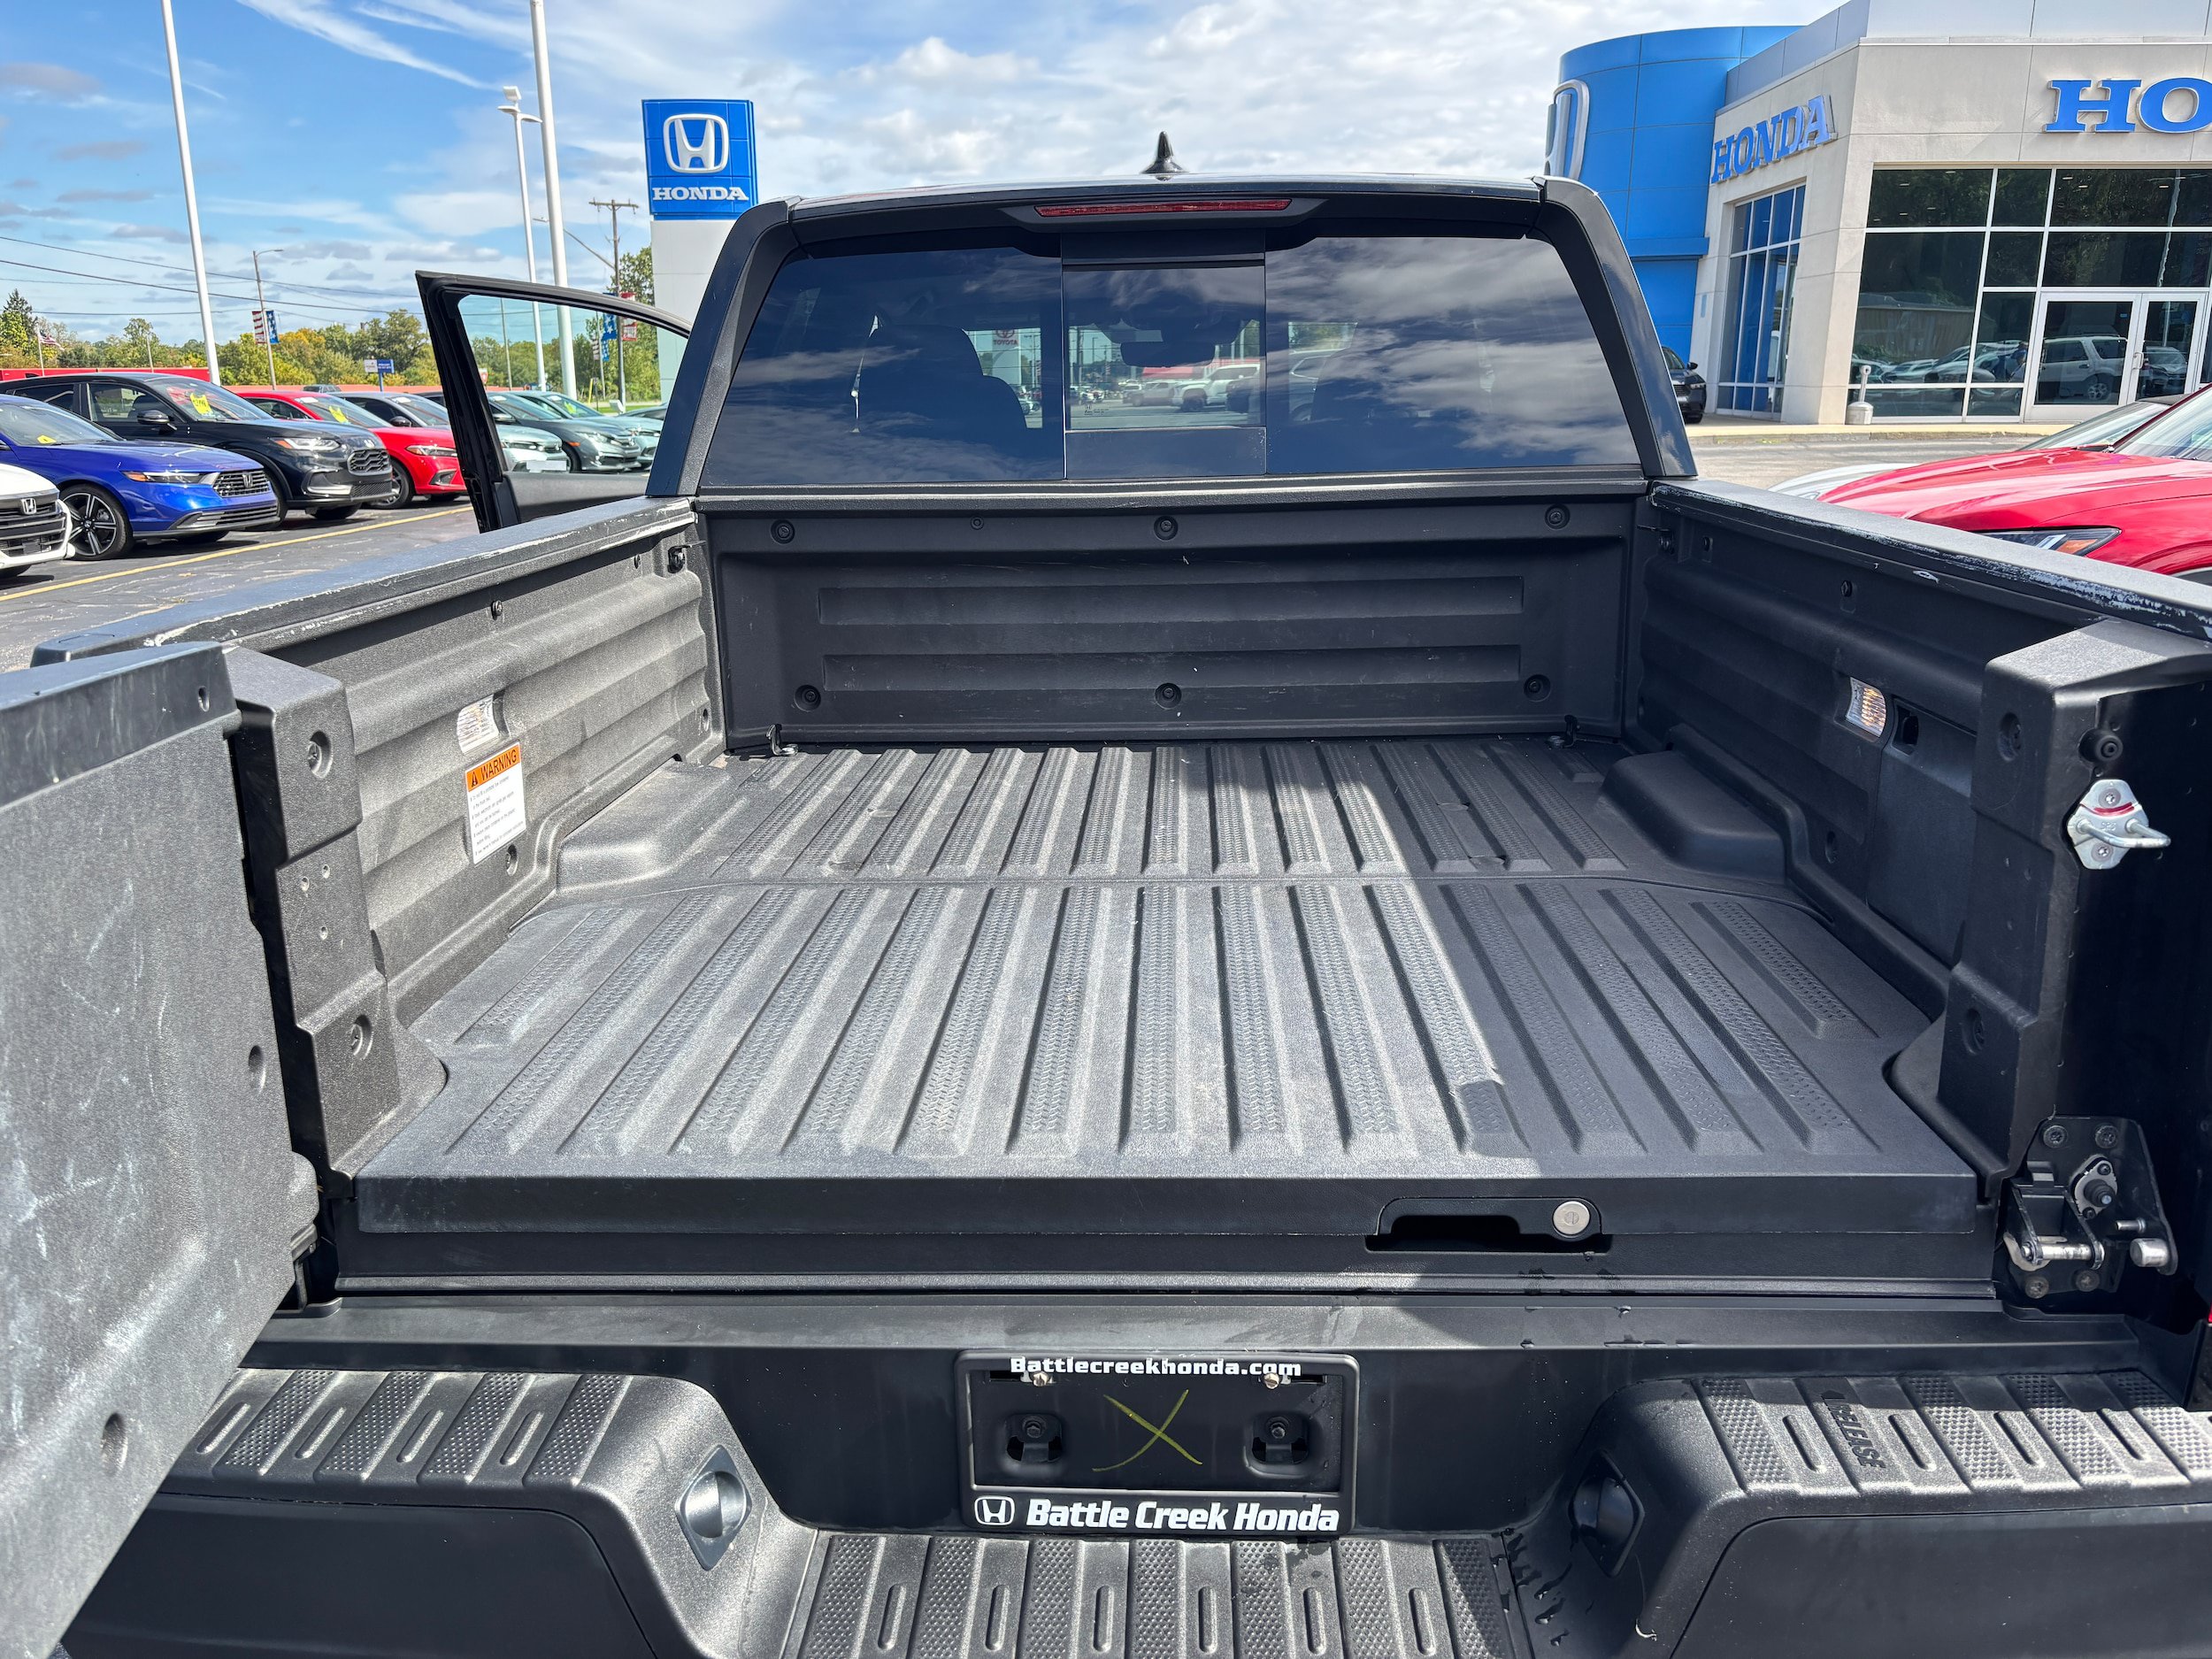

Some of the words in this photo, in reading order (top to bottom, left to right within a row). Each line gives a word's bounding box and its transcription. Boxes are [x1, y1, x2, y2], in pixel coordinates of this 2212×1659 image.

[1710, 95, 1832, 184] HONDA
[652, 187, 749, 201] HONDA
[480, 749, 517, 781] WARNING
[1010, 1356, 1302, 1377] Battlecreekhonda.com
[1829, 1403, 1886, 1469] RELEASE
[1026, 1499, 1130, 1528] Battle
[1134, 1501, 1229, 1531] Creek
[1233, 1503, 1340, 1532] Honda
